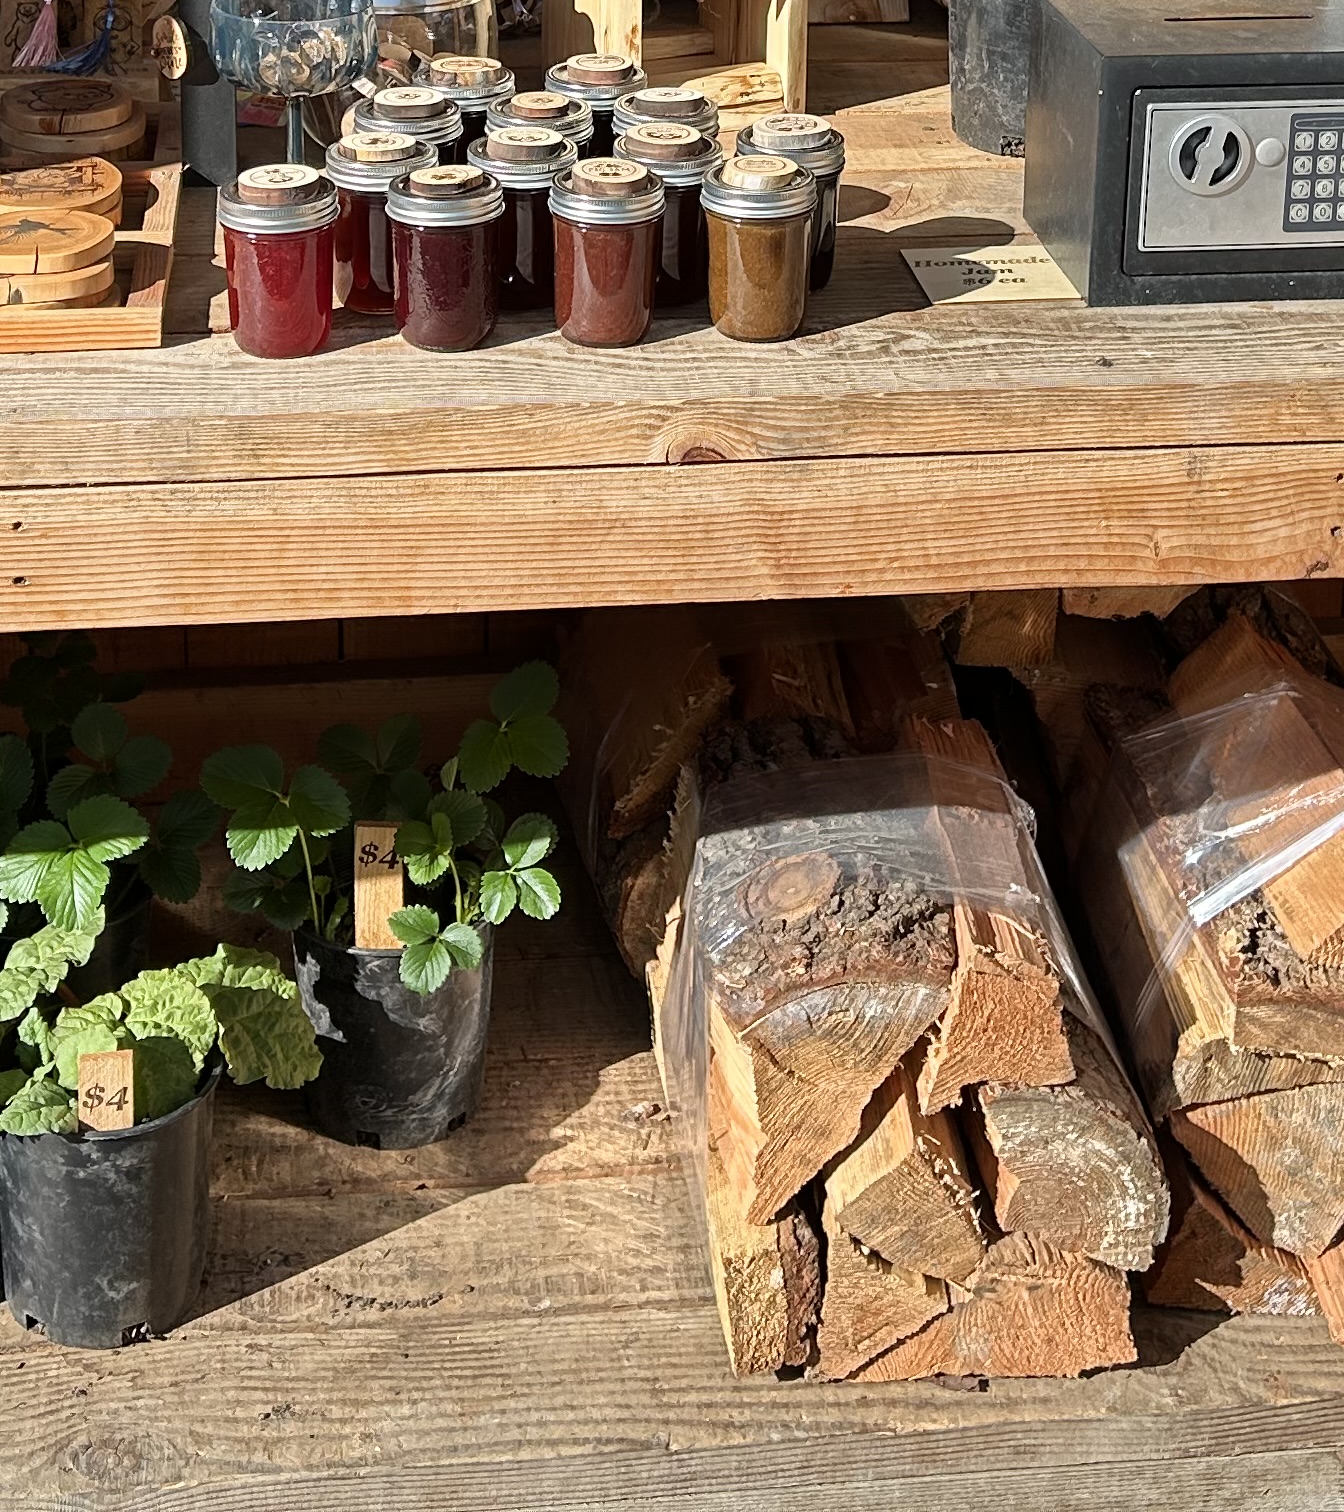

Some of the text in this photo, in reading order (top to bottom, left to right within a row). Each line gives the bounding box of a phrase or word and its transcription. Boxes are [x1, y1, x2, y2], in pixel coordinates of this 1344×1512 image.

[914, 256, 1052, 268] Homemade
[357, 840, 401, 872] $4
[81, 1082, 130, 1114] $4
